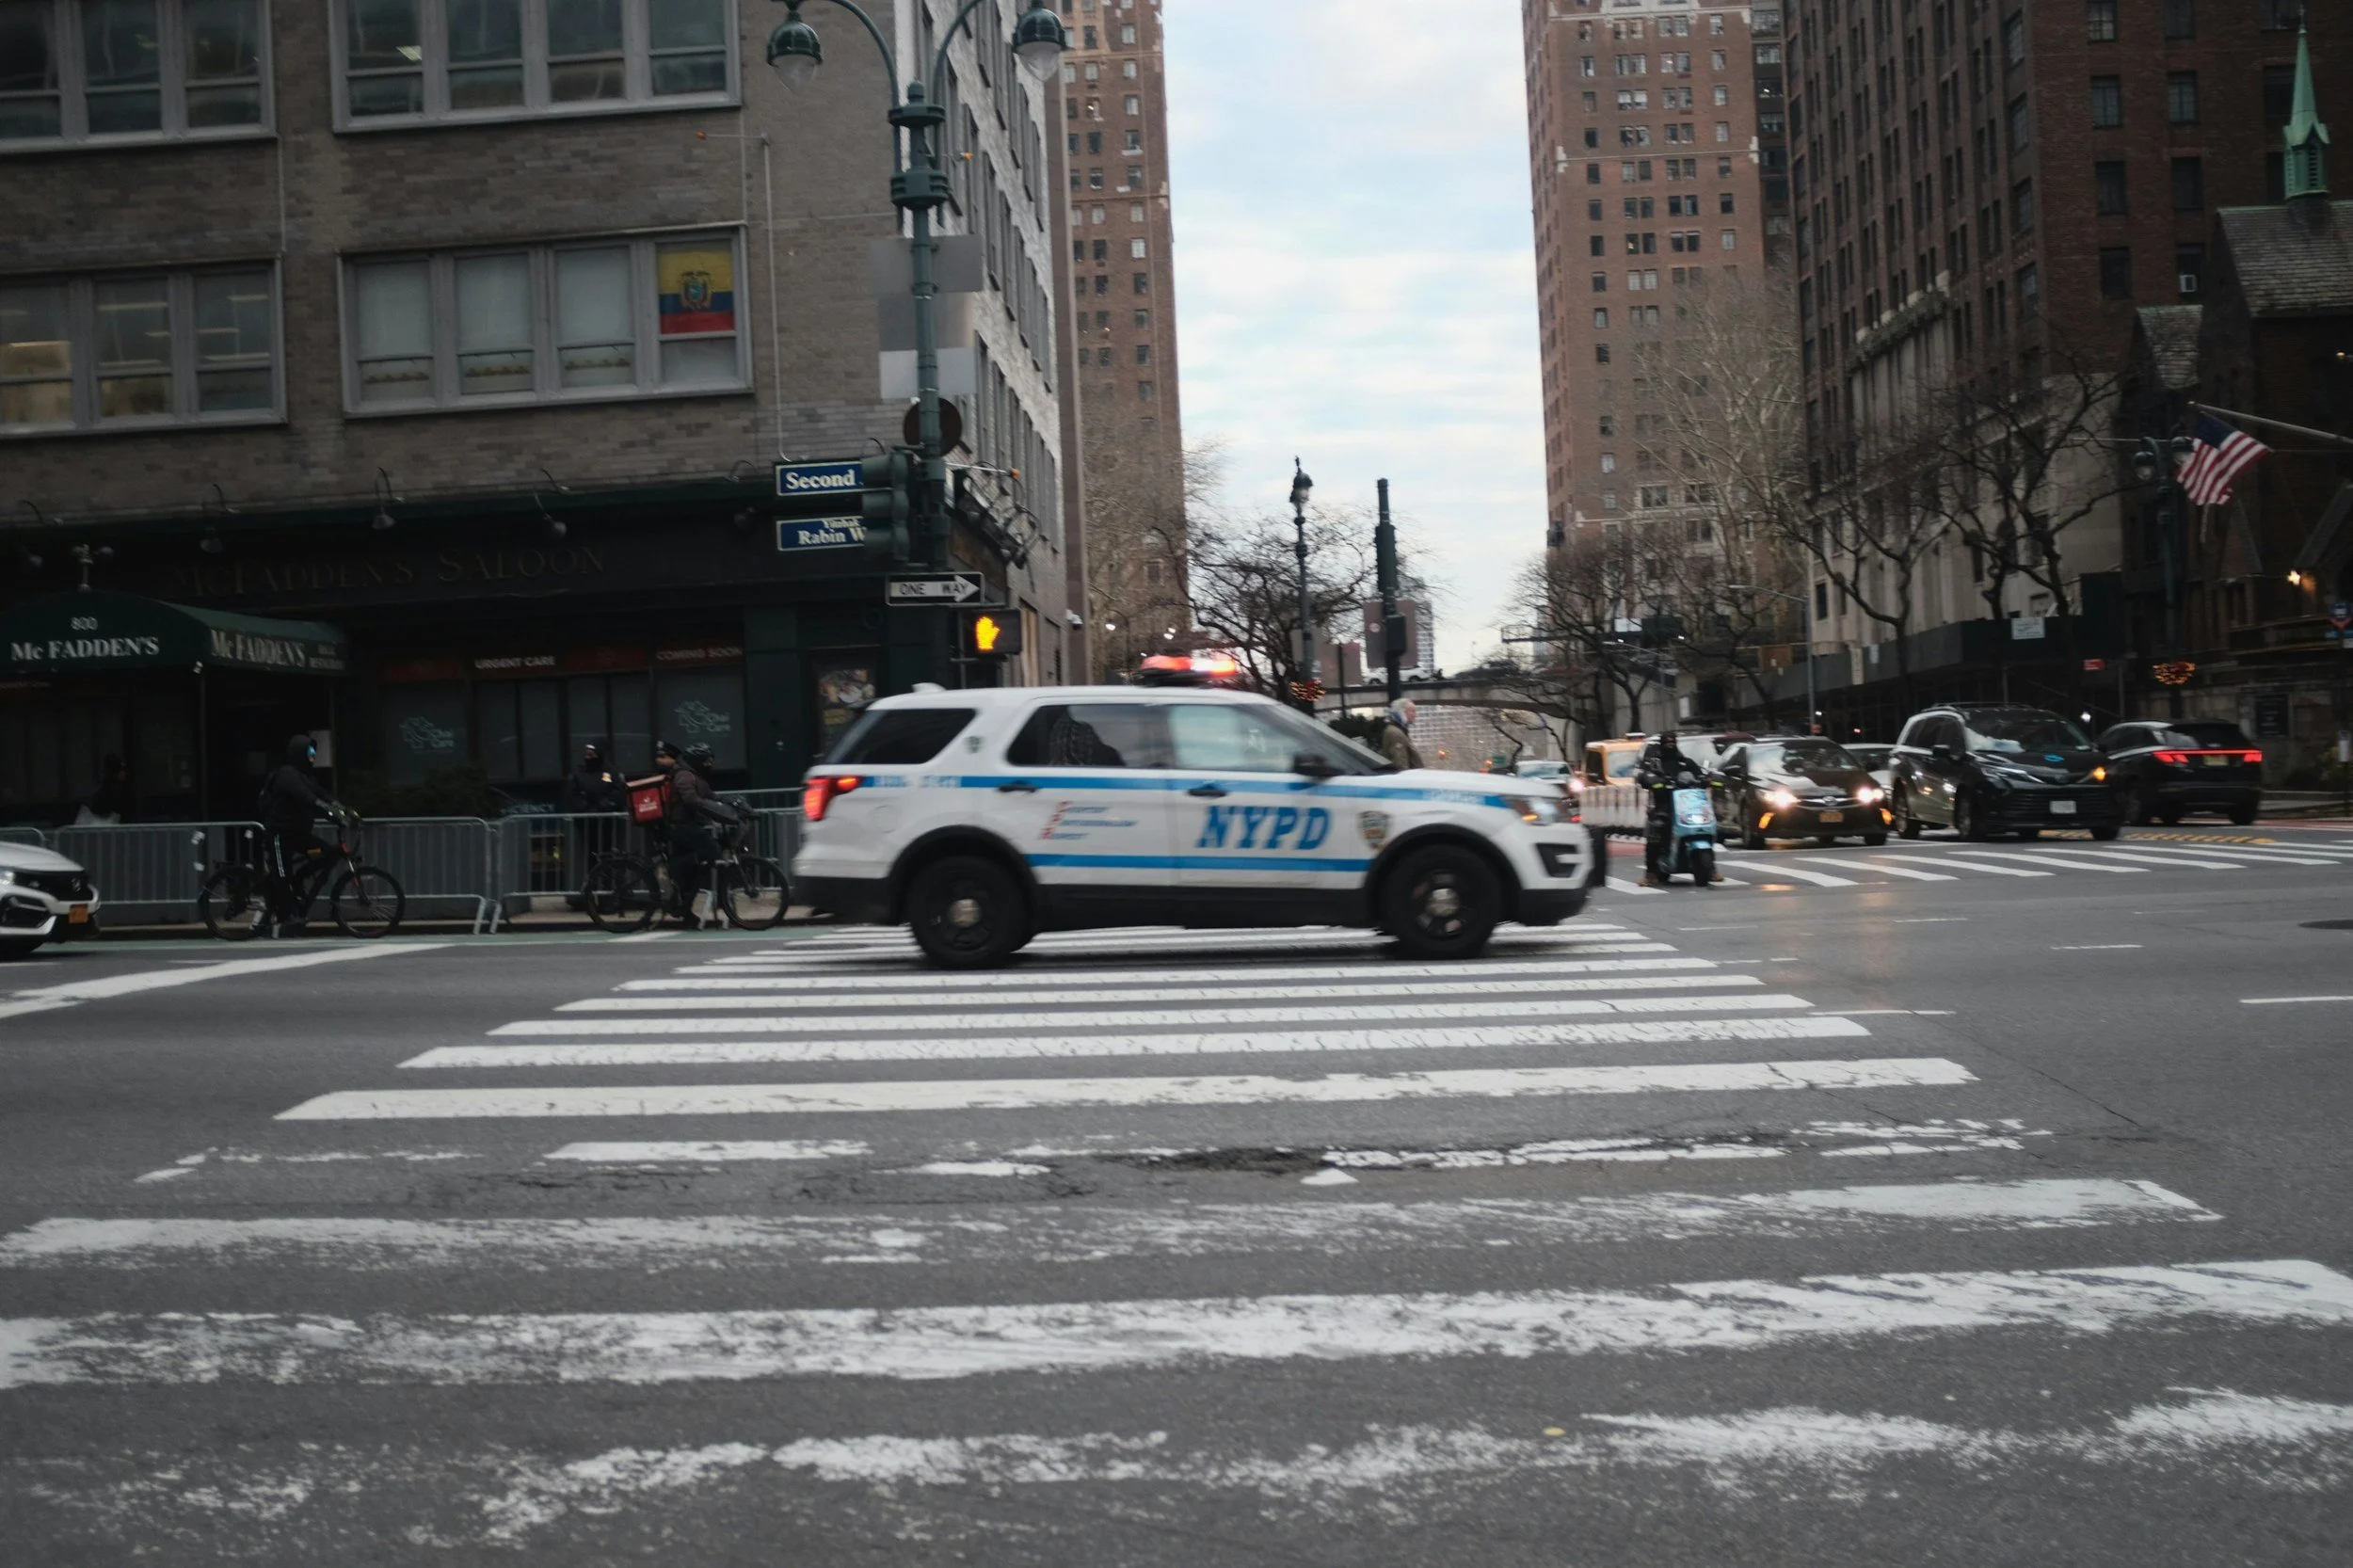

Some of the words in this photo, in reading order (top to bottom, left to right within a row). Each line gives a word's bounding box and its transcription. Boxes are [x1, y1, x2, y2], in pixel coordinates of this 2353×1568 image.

[786, 469, 856, 489] Second
[797, 528, 846, 545] Rabin
[436, 546, 604, 582] SALOON
[899, 583, 927, 596] ONE
[941, 583, 969, 595] WAY
[71, 616, 98, 631] 800
[10, 642, 44, 661] Mc
[47, 635, 160, 660] FADDEN'S
[210, 629, 234, 658] Mc
[473, 656, 521, 670] URGENT
[523, 654, 557, 667] CARE
[656, 648, 706, 661] COMING
[707, 646, 743, 658] SOON
[1194, 805, 1334, 851] NYPD
